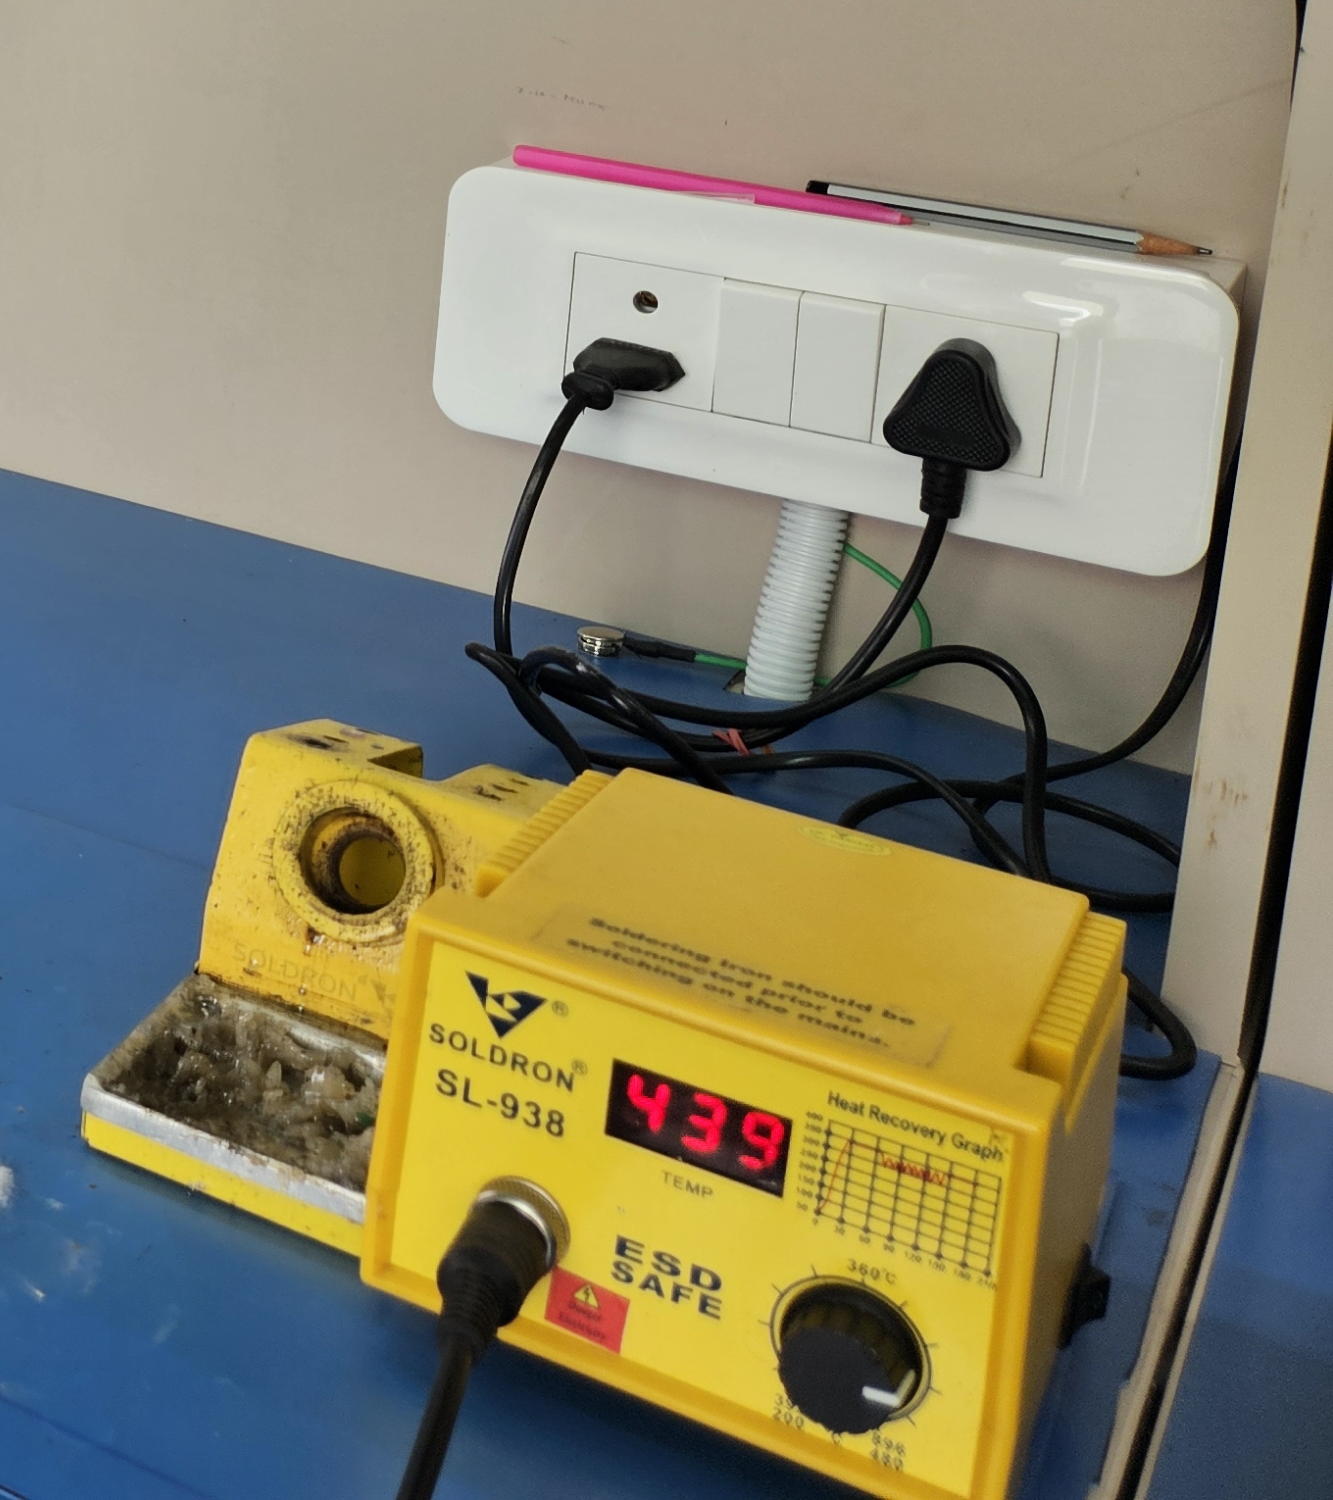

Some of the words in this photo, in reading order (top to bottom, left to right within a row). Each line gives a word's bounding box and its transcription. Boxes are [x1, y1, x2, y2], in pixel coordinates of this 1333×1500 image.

[702, 983, 735, 999] on
[743, 994, 789, 1015] the
[780, 978, 874, 1013] should
[882, 1008, 916, 1027] be
[835, 1009, 863, 1024] to
[428, 1022, 575, 1093] SOLDRON
[435, 1068, 565, 1138] SL-938
[625, 1073, 789, 1173] 439
[827, 1090, 866, 1115] Heat
[868, 1105, 948, 1146] Recovery
[950, 1134, 1004, 1162] Graph
[660, 1168, 714, 1201] TEMP
[611, 1260, 723, 1320] SAFE
[614, 1234, 722, 1292] ESD
